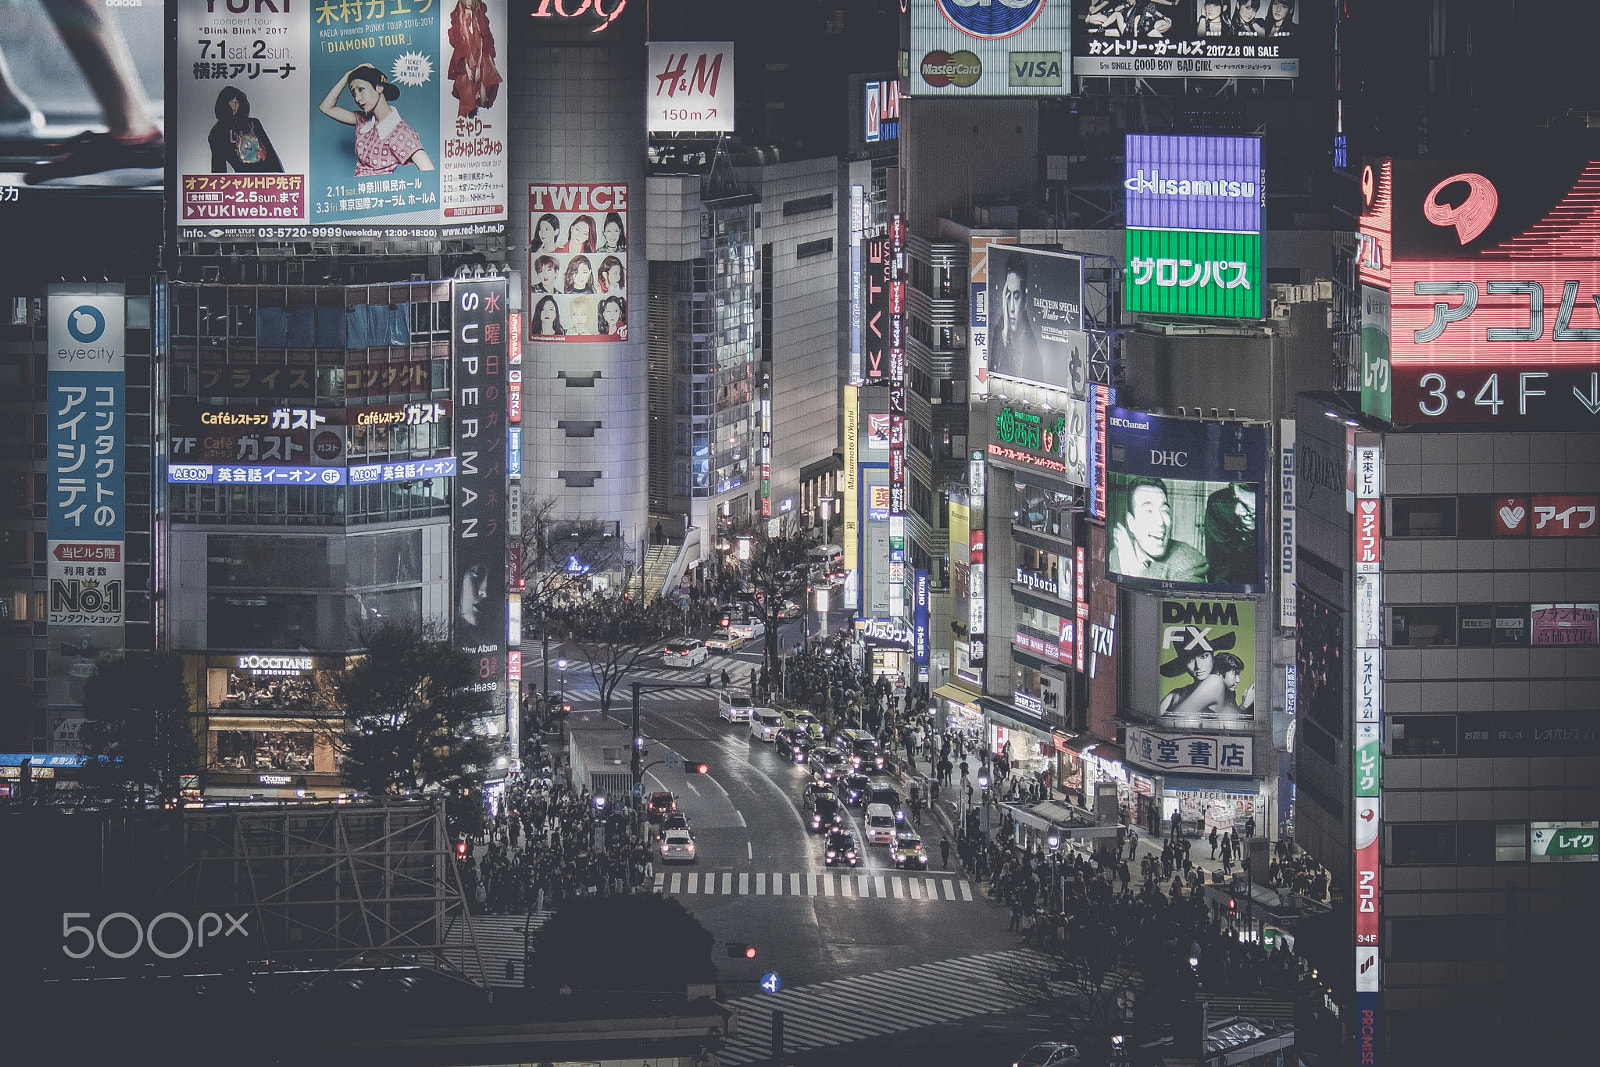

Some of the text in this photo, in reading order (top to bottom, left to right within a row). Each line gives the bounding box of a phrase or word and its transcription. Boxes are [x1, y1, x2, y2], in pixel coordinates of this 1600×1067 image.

[266, 27, 288, 35] 2017
[365, 23, 385, 34] PUNKY
[387, 21, 403, 30] TOUR
[1088, 39, 1280, 57] カントリー・ガールズ 2017.2.8 ON SALE
[193, 63, 296, 80] 横浜アリーナ
[655, 53, 724, 98] H&M
[921, 63, 981, 76] MasterCard
[1014, 61, 1061, 78] VISA
[1111, 61, 1133, 71] SINGLE
[1134, 59, 1156, 71] GOOD
[1157, 60, 1173, 71] BOY
[1177, 60, 1194, 72] BAD
[1195, 60, 1213, 72] GIRL
[455, 117, 492, 137] きゃりー
[185, 176, 302, 190] オフィシャルHP先行
[357, 178, 423, 194] 神奈川県民ホール
[1124, 168, 1256, 198] Hisamitsu
[0, 187, 19, 201] 力
[339, 192, 437, 212] 東京国際フォーラム ホールA
[530, 186, 627, 210] TWICE
[197, 204, 299, 218] YUKIweb.net
[183, 228, 207, 239] info.
[258, 227, 342, 239] 03-5720-9999
[342, 229, 383, 238] (weekday
[1130, 256, 1252, 290] サロンパス
[1058, 301, 1080, 314] SPECIAL
[1414, 280, 1600, 344] アコム
[57, 347, 115, 364] eyecity
[201, 368, 311, 391] プライス
[346, 363, 428, 390] コンタクト
[1364, 352, 1389, 394] レイク
[271, 408, 326, 430] ガスト
[405, 403, 446, 425] ガスト
[461, 291, 479, 539] SUPERMAN
[1110, 416, 1150, 431] DHC Channel
[57, 386, 88, 527] アイシティ
[94, 386, 117, 527] コンタクトの
[171, 436, 197, 454] 7F
[236, 433, 304, 461] ガスト
[1151, 449, 1188, 467] DHC
[174, 469, 208, 481] AEON
[217, 467, 317, 483] 英会話イーオン
[353, 461, 456, 482] AEON 英会話イーオン
[1282, 517, 1294, 574] neon
[1362, 514, 1375, 562] アイフル
[62, 547, 117, 560] 当ビル5階
[63, 566, 108, 577] 利用者数
[1016, 567, 1058, 594] Euphoria
[50, 578, 122, 614] No.1
[918, 576, 926, 606] MIZUHO
[50, 614, 122, 624] コンタクトショップ
[1162, 601, 1239, 626] DMM
[477, 644, 498, 653] Album
[1162, 626, 1214, 651] FX
[1128, 731, 1246, 769] 大盛堂書店
[1360, 749, 1375, 791] レイク
[1559, 834, 1594, 848] レイク
[1359, 870, 1375, 913] アコム
